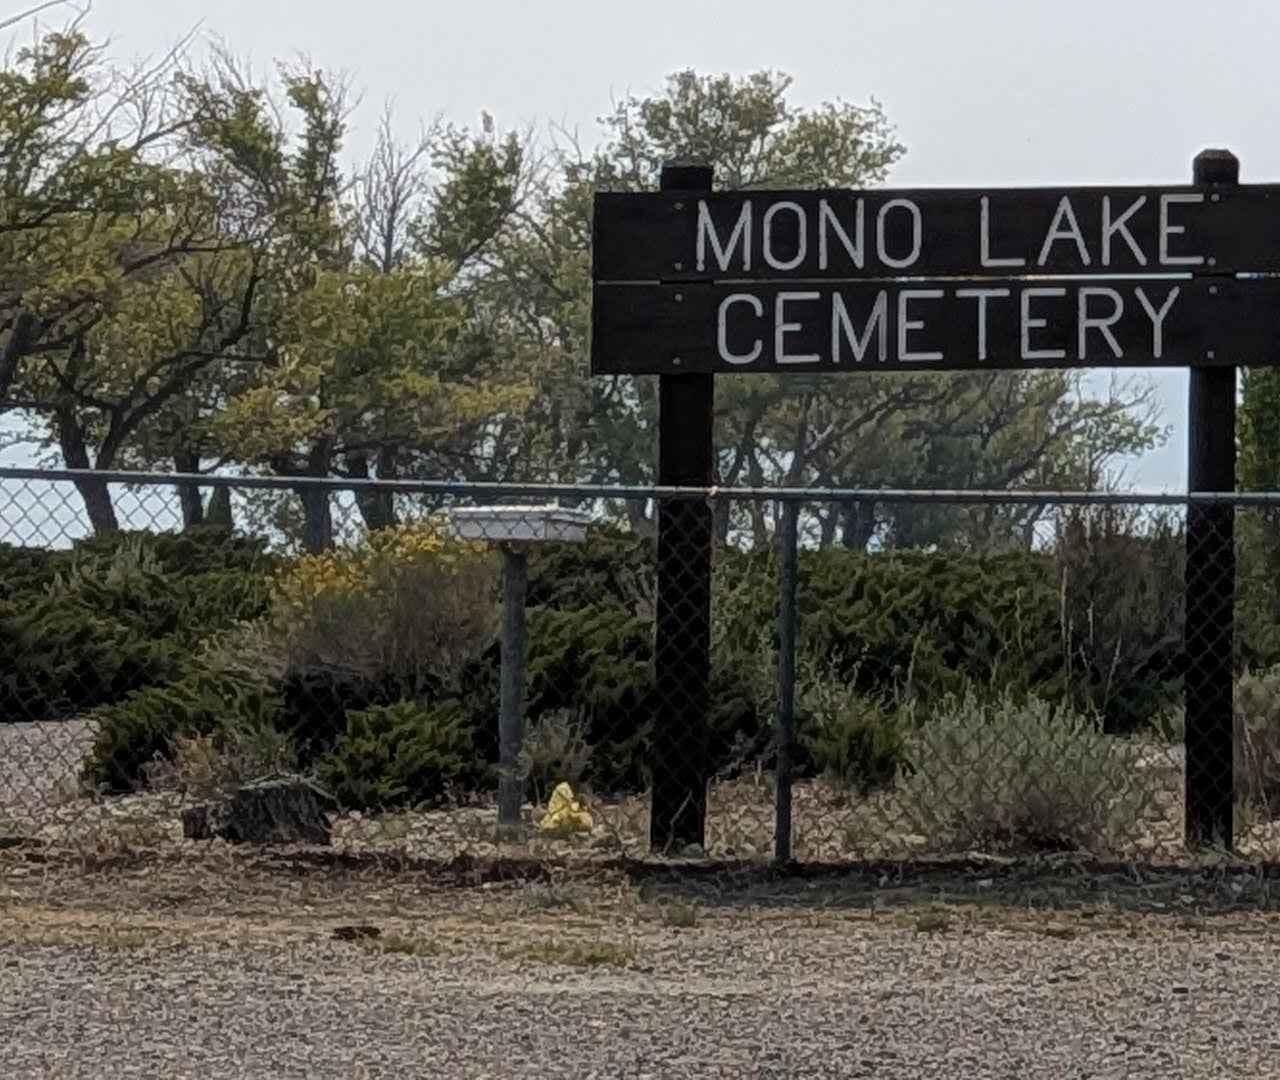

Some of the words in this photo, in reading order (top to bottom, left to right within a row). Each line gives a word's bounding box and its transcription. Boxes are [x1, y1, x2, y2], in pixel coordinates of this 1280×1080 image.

[695, 198, 923, 272] MONO
[979, 193, 1205, 267] LAKE
[716, 286, 1181, 366] CEMETERY
